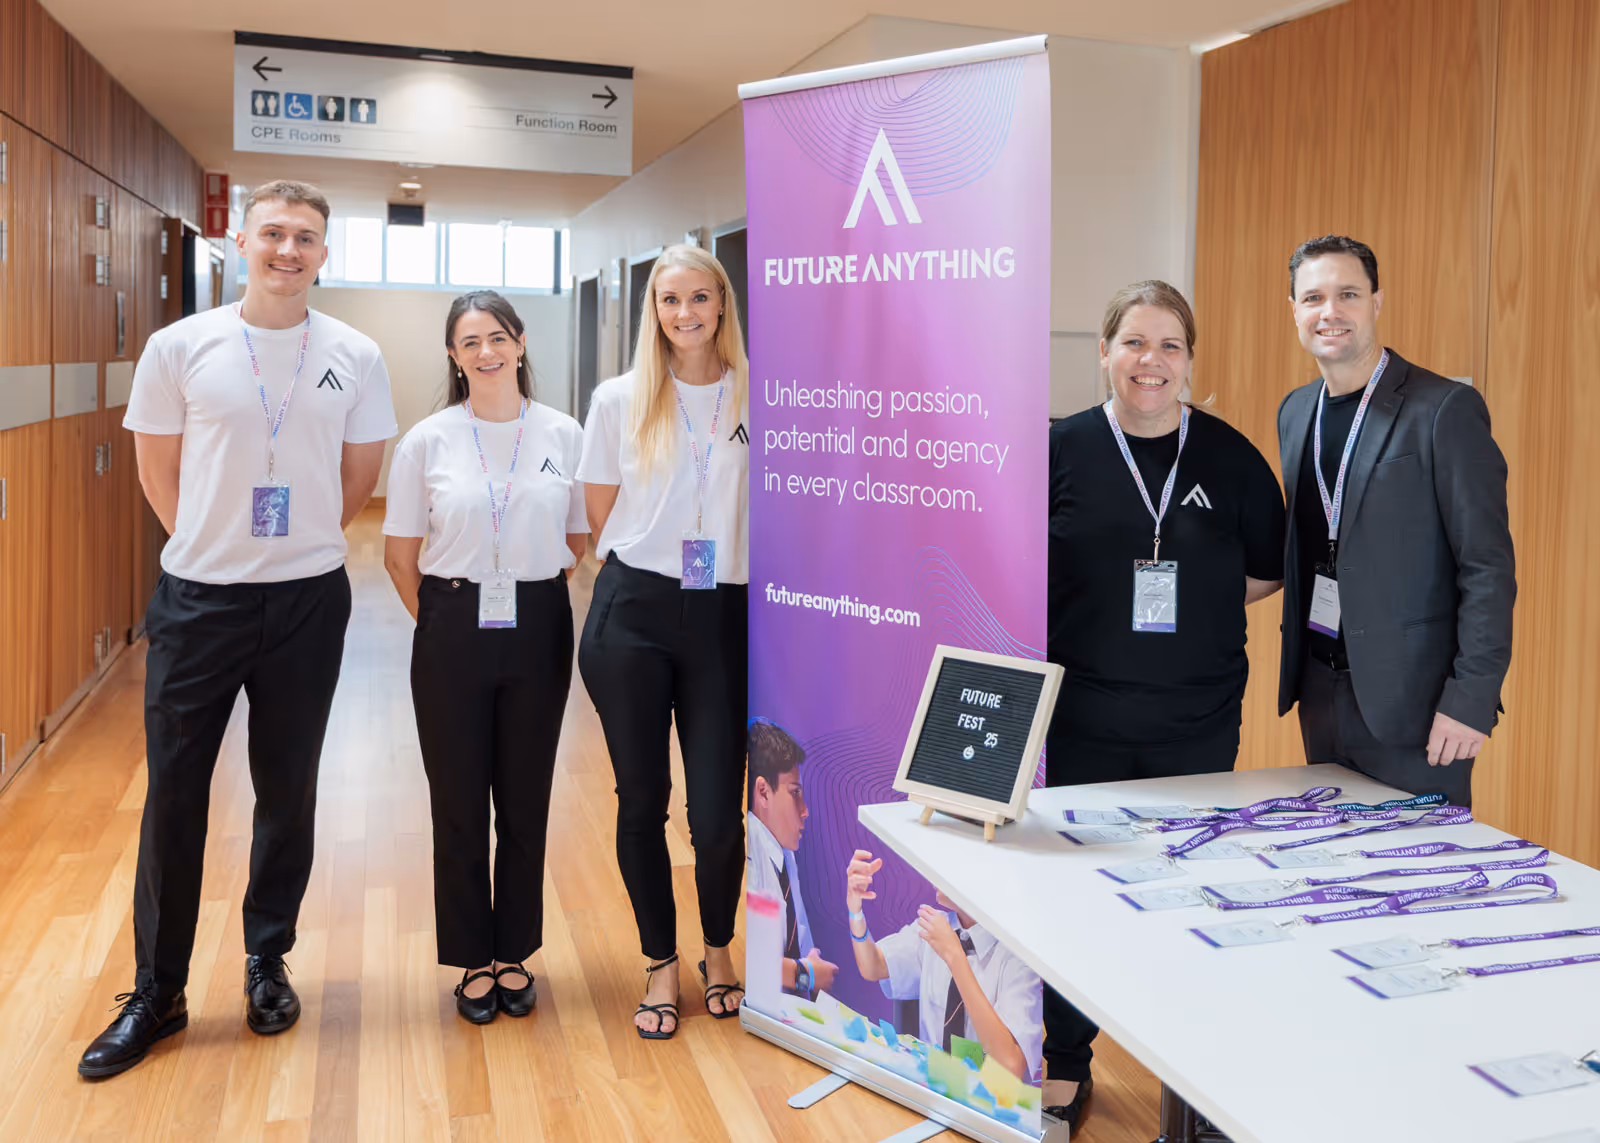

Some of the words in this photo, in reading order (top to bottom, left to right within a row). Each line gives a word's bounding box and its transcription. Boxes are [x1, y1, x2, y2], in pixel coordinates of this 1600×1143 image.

[516, 115, 575, 130] Function
[579, 120, 617, 133] Room
[251, 127, 283, 140] CPE
[289, 129, 341, 144] Rooms
[765, 254, 858, 286] FUTURE
[862, 247, 1015, 282] ANYTHING
[765, 380, 882, 418] Unleashing
[891, 386, 989, 419] passion,
[765, 425, 854, 455] potential
[862, 429, 908, 458] and
[916, 439, 1009, 472] agency
[765, 467, 780, 492] in
[787, 476, 847, 505] every
[853, 473, 983, 512] classroom.
[1331, 490, 1341, 525] ANYTHING
[766, 583, 921, 627] futureanything.com
[960, 688, 1002, 708] FUTURE
[957, 713, 986, 731] FEST
[984, 732, 999, 748] 25
[1277, 799, 1306, 809] FUTURE
[1416, 794, 1443, 805] FUTURE
[1296, 818, 1324, 829] FUTURE
[1190, 830, 1215, 847] ANYTHING
[1374, 847, 1419, 857] ANYTHING
[1504, 875, 1545, 889] ANYTHING
[1267, 895, 1314, 907] ANYTHING
[1319, 911, 1364, 921] ANYTHING
